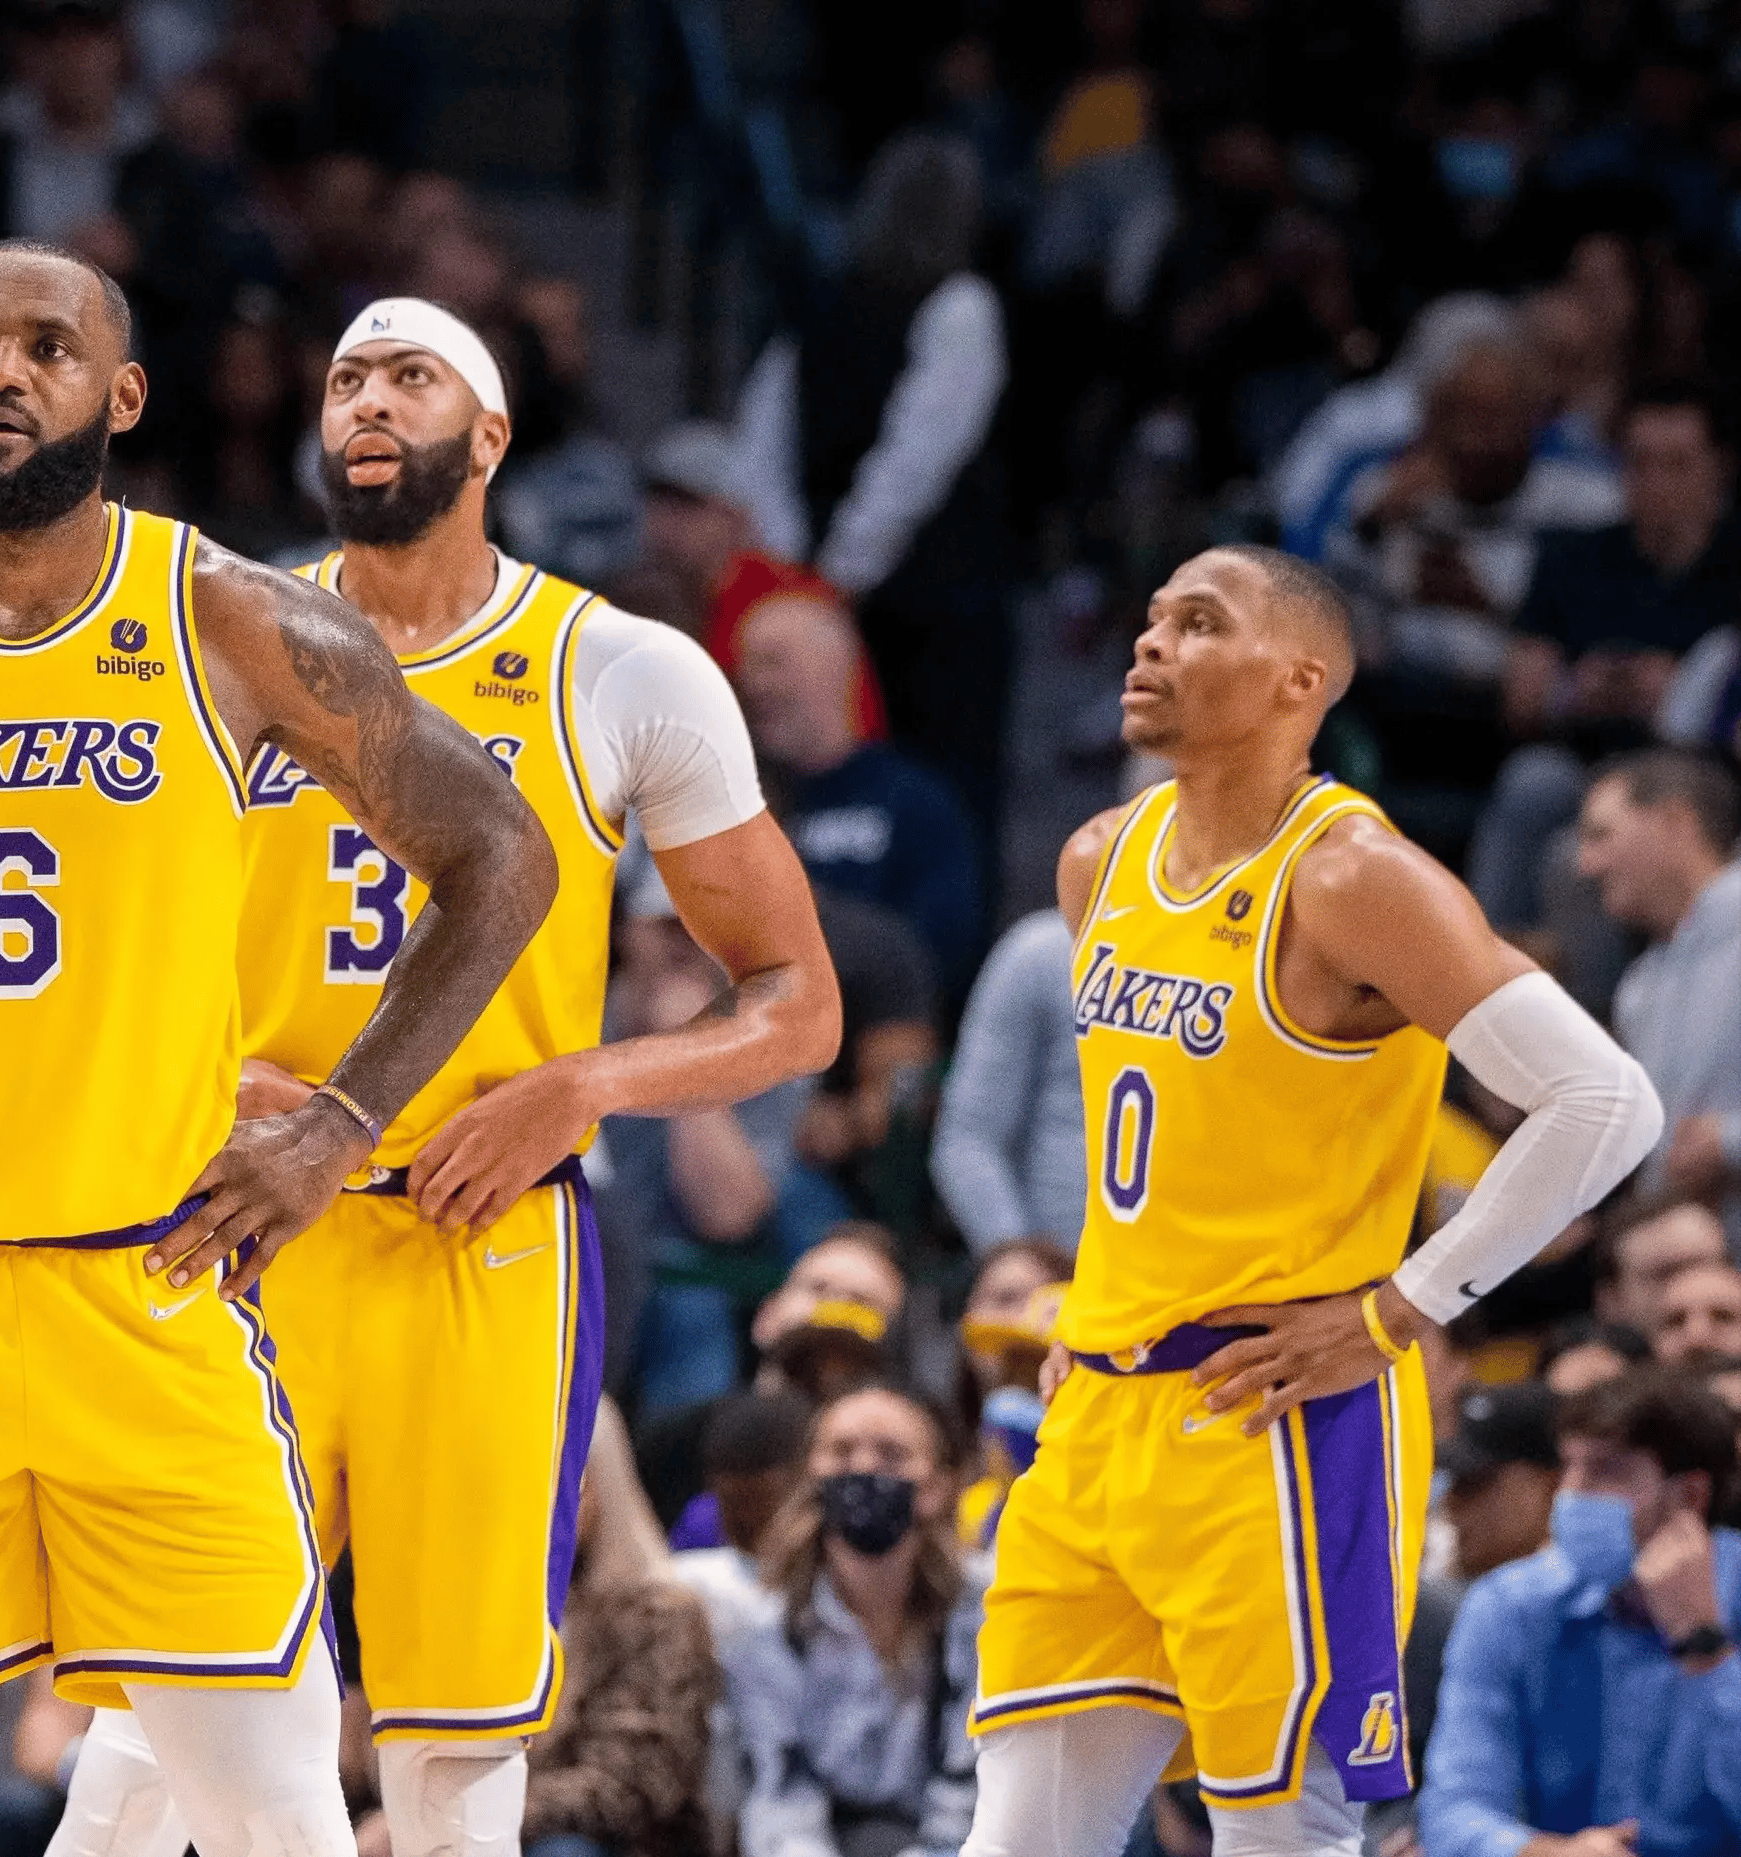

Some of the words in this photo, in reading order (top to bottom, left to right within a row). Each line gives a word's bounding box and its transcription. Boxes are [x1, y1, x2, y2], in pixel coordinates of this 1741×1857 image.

[96, 655, 166, 682] bibigo
[473, 681, 540, 706] bibigo
[324, 824, 411, 985] 3
[1074, 943, 1237, 1061] LAKERS
[1100, 1064, 1158, 1225] 0
